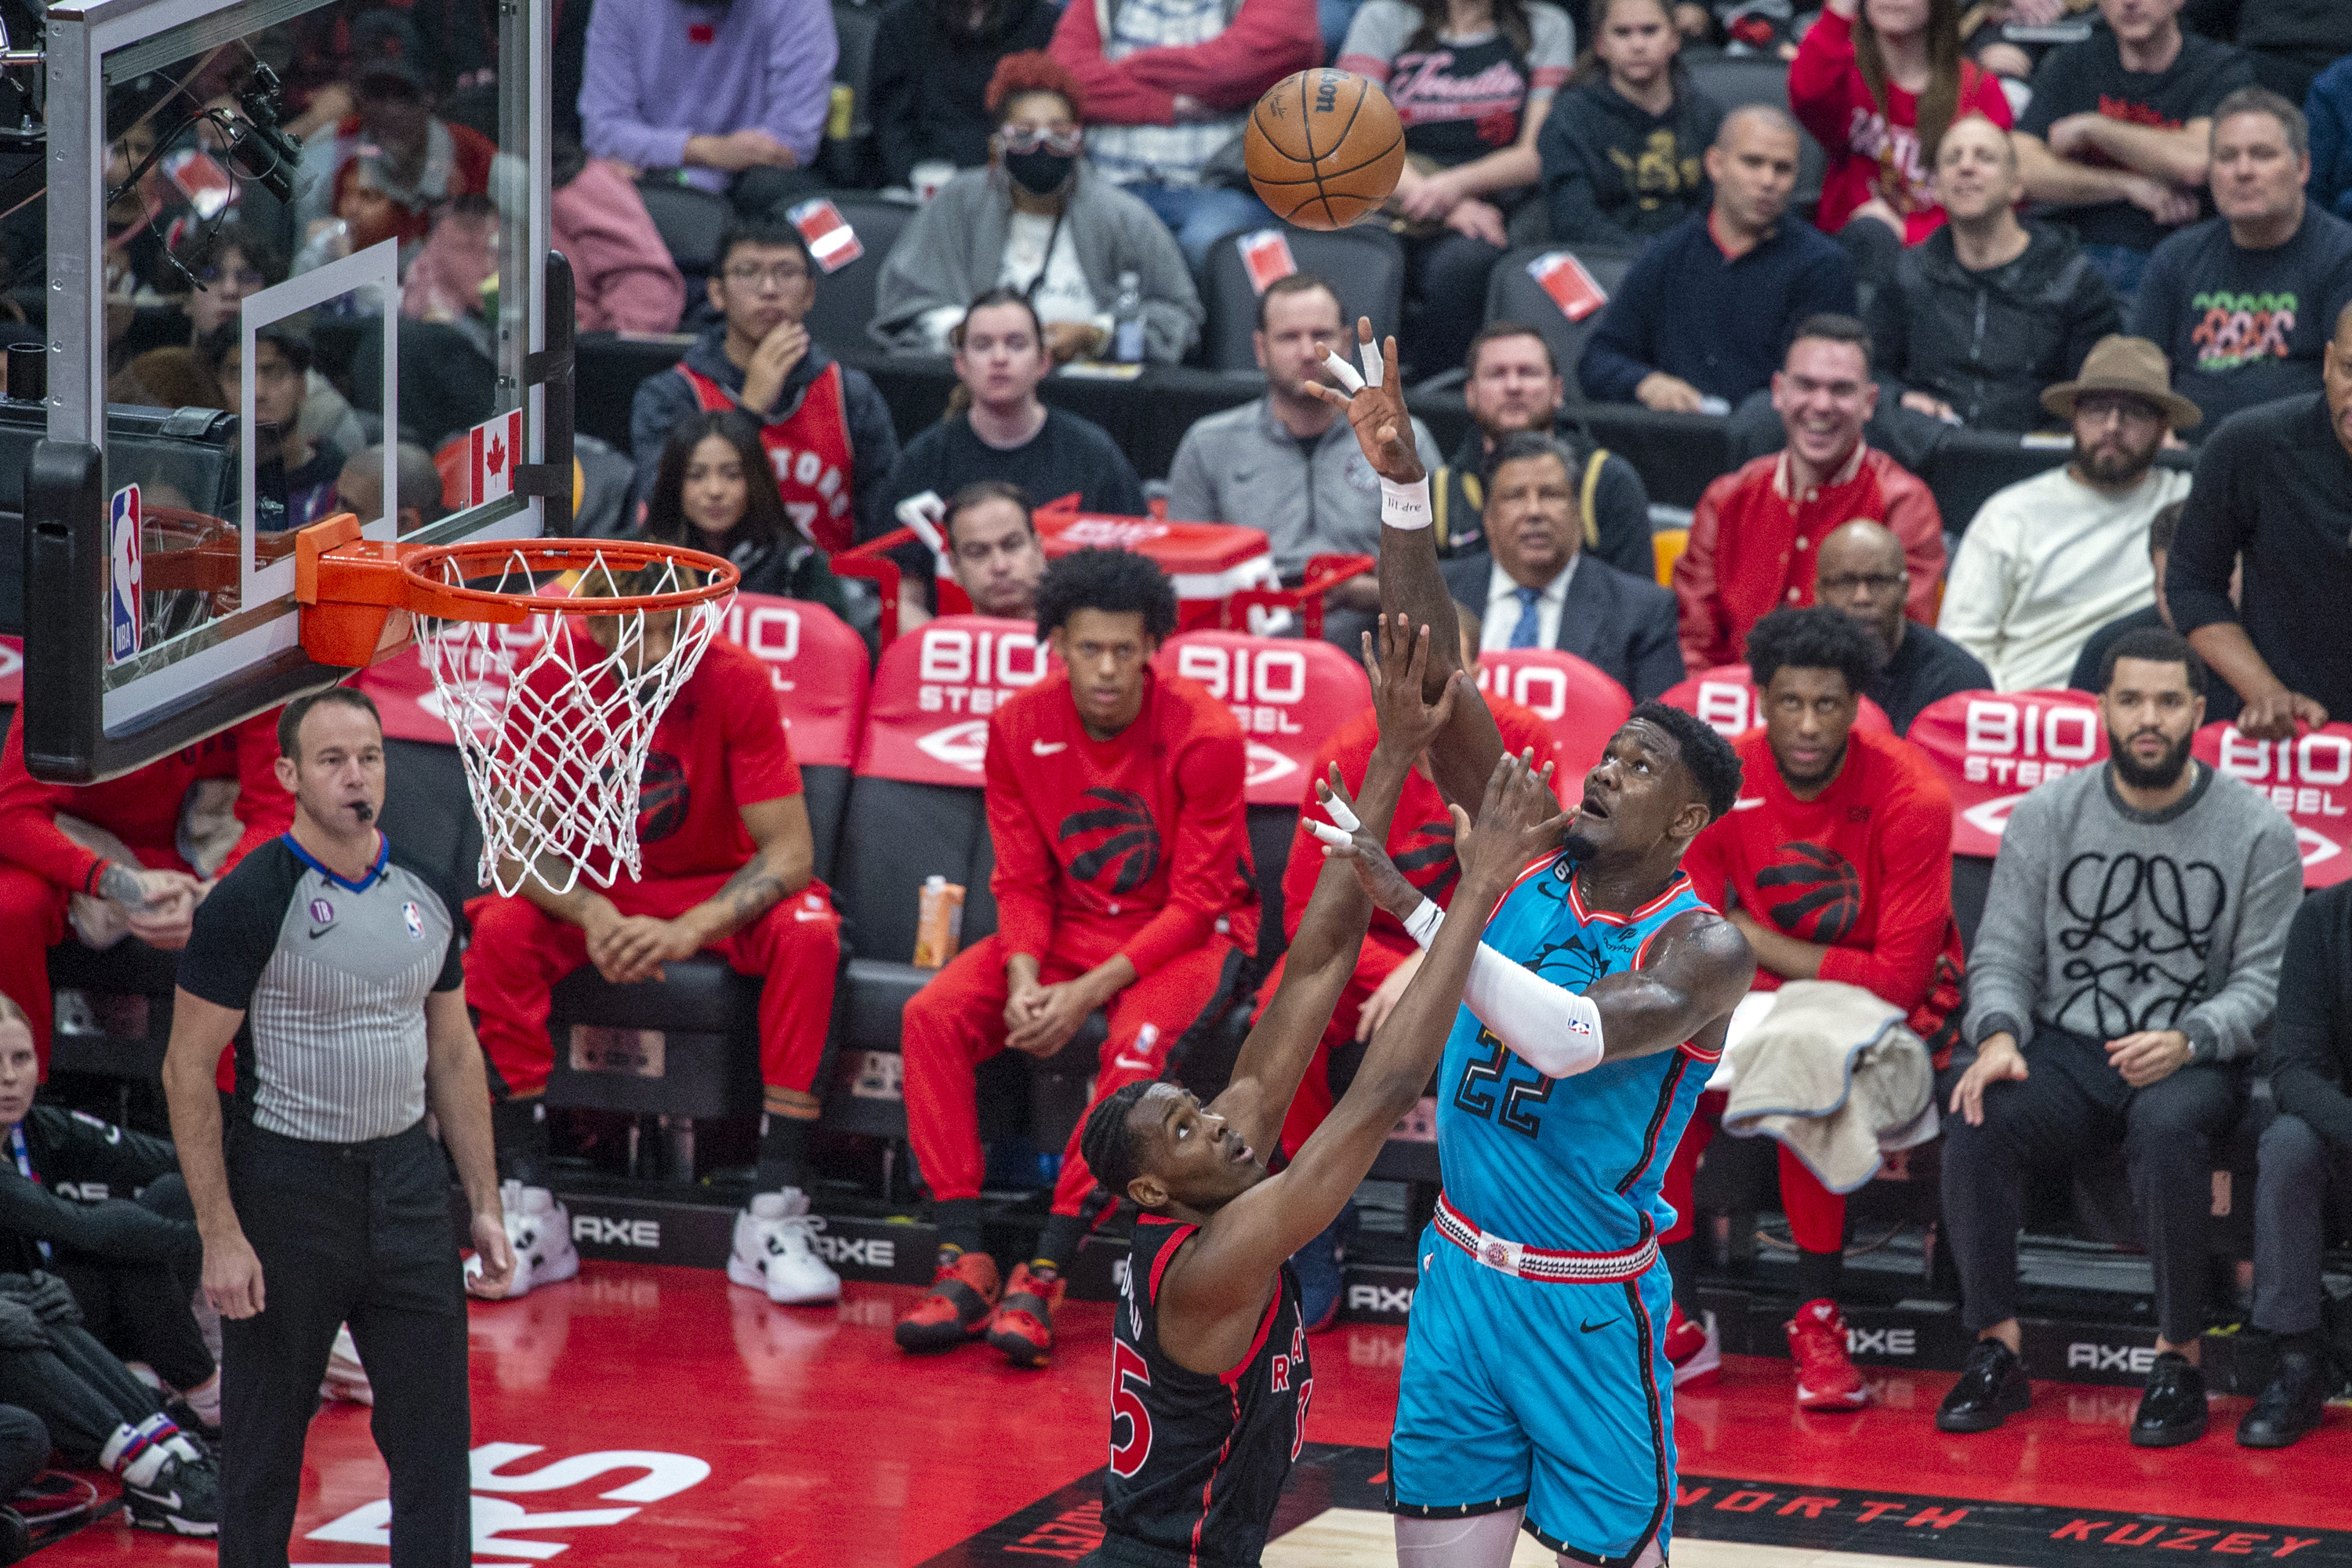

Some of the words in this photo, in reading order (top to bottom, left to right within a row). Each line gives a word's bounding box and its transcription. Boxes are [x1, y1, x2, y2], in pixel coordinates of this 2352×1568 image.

[1401, 502, 1422, 513] dre
[117, 621, 132, 653] NBA
[920, 630, 1051, 687] BIO
[1966, 699, 2098, 760] BIO
[1964, 755, 2082, 787] STEE
[2220, 725, 2352, 786] BIO
[1554, 861, 1570, 881] 6
[1602, 937, 1637, 954] PayPal
[1453, 1022, 1558, 1140] 22
[572, 1214, 660, 1248] AXE
[2067, 1342, 2158, 1374] AXE
[1110, 1336, 1152, 1479] 5
[1675, 1485, 1970, 1530] NORTH
[2049, 1519, 2321, 1559] KUZEY
